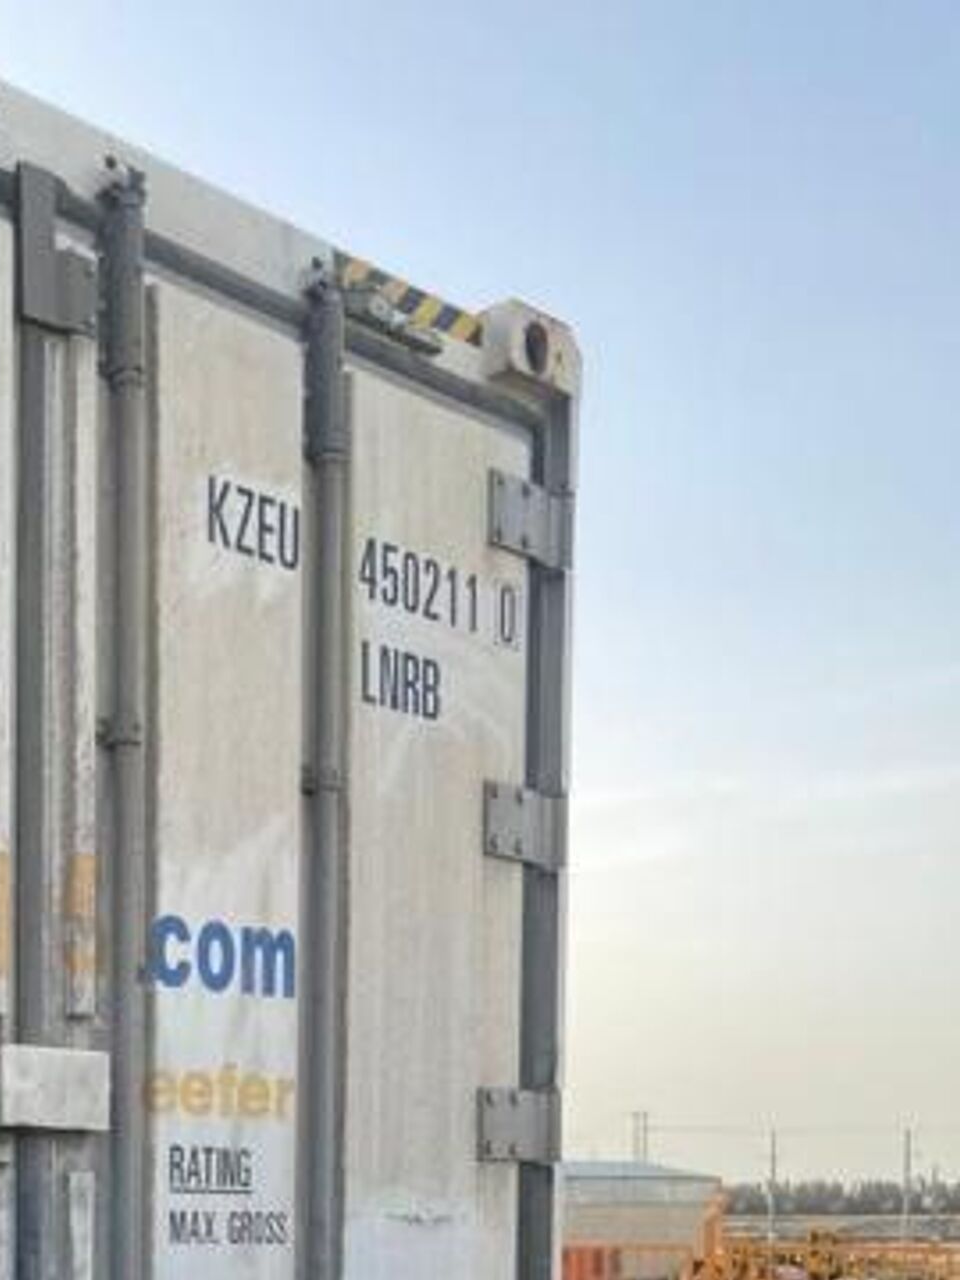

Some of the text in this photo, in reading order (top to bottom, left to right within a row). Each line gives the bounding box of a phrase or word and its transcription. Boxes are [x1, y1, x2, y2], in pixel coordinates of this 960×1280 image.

[207, 475, 516, 643] KZEU 450211 0
[361, 641, 441, 720] LNRB
[146, 1064, 295, 1118] eefer
[169, 1145, 253, 1194] RATING
[227, 1211, 289, 1244] GROSS
